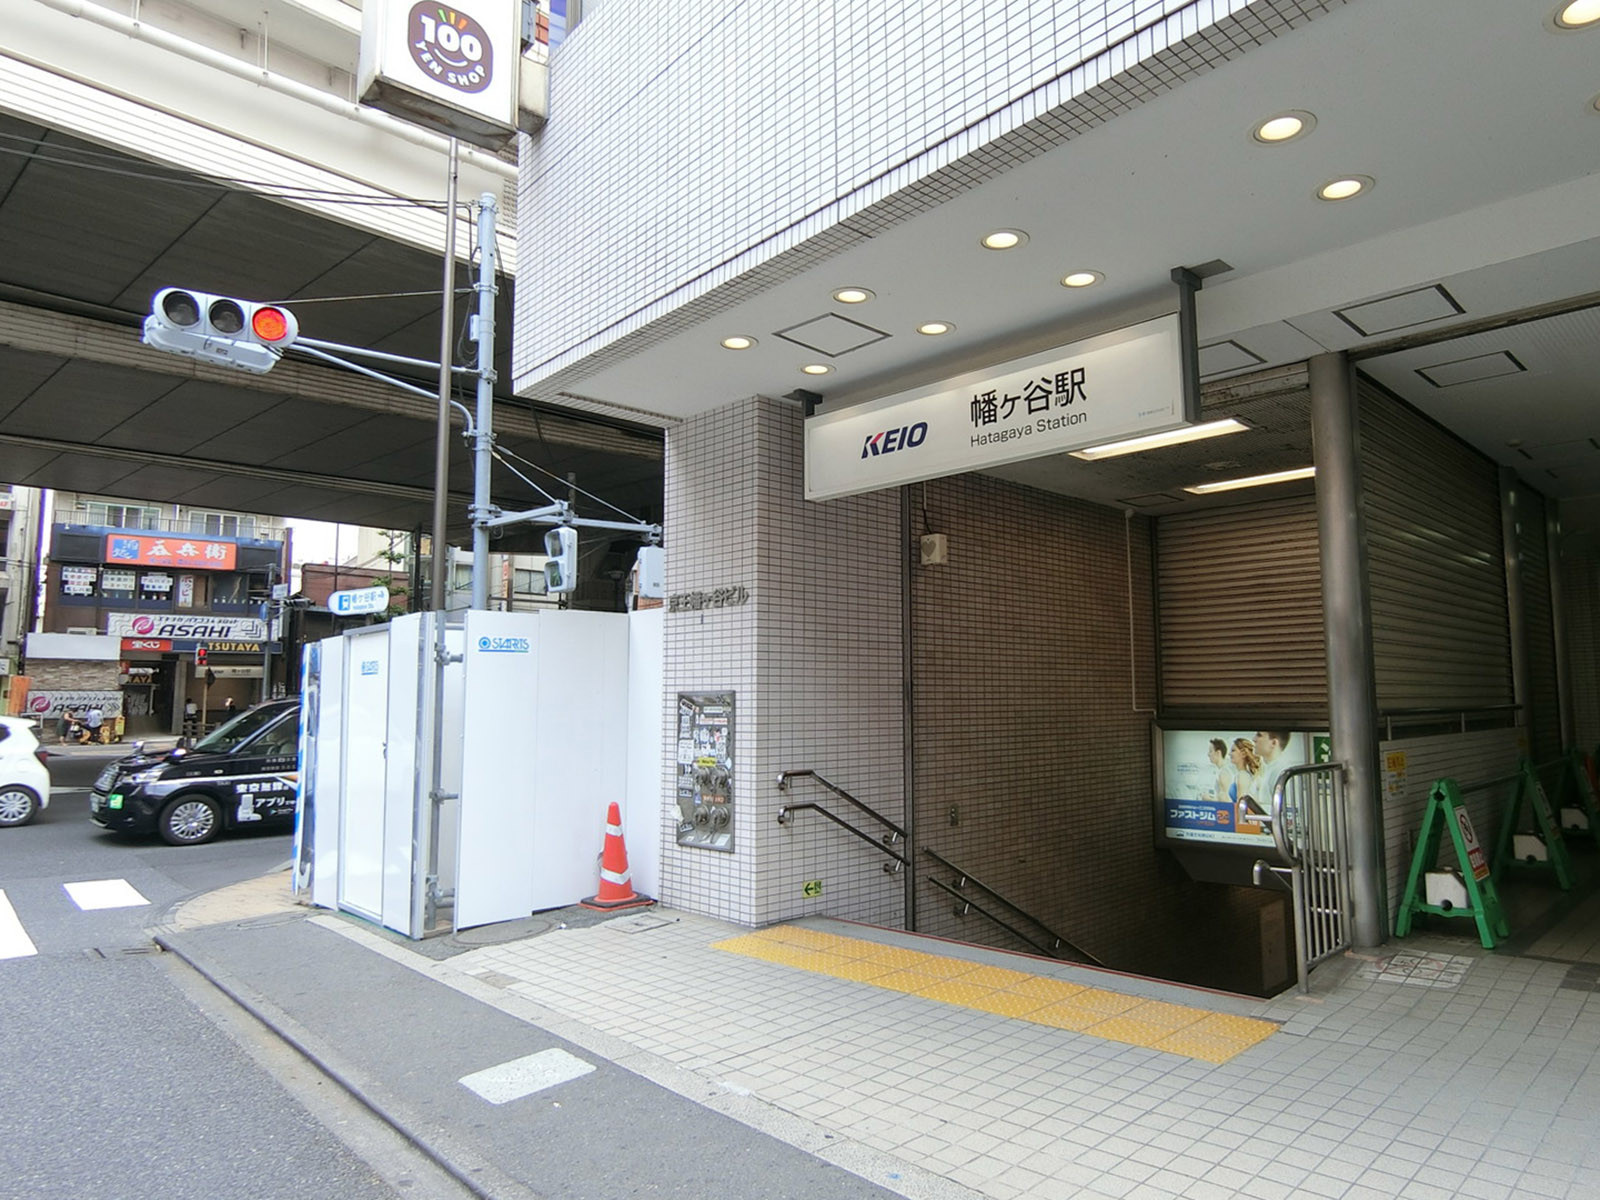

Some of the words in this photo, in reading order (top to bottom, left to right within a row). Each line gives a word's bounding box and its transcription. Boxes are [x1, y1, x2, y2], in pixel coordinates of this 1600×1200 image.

[420, 15, 482, 61] 100
[416, 41, 443, 75] YEN
[448, 65, 485, 86] SHOP
[861, 421, 928, 459] KEIO
[970, 421, 1033, 447] Hatagaya
[1037, 410, 1087, 433] Station
[158, 624, 232, 638] ASAHI
[208, 642, 261, 652] TSUTAYA
